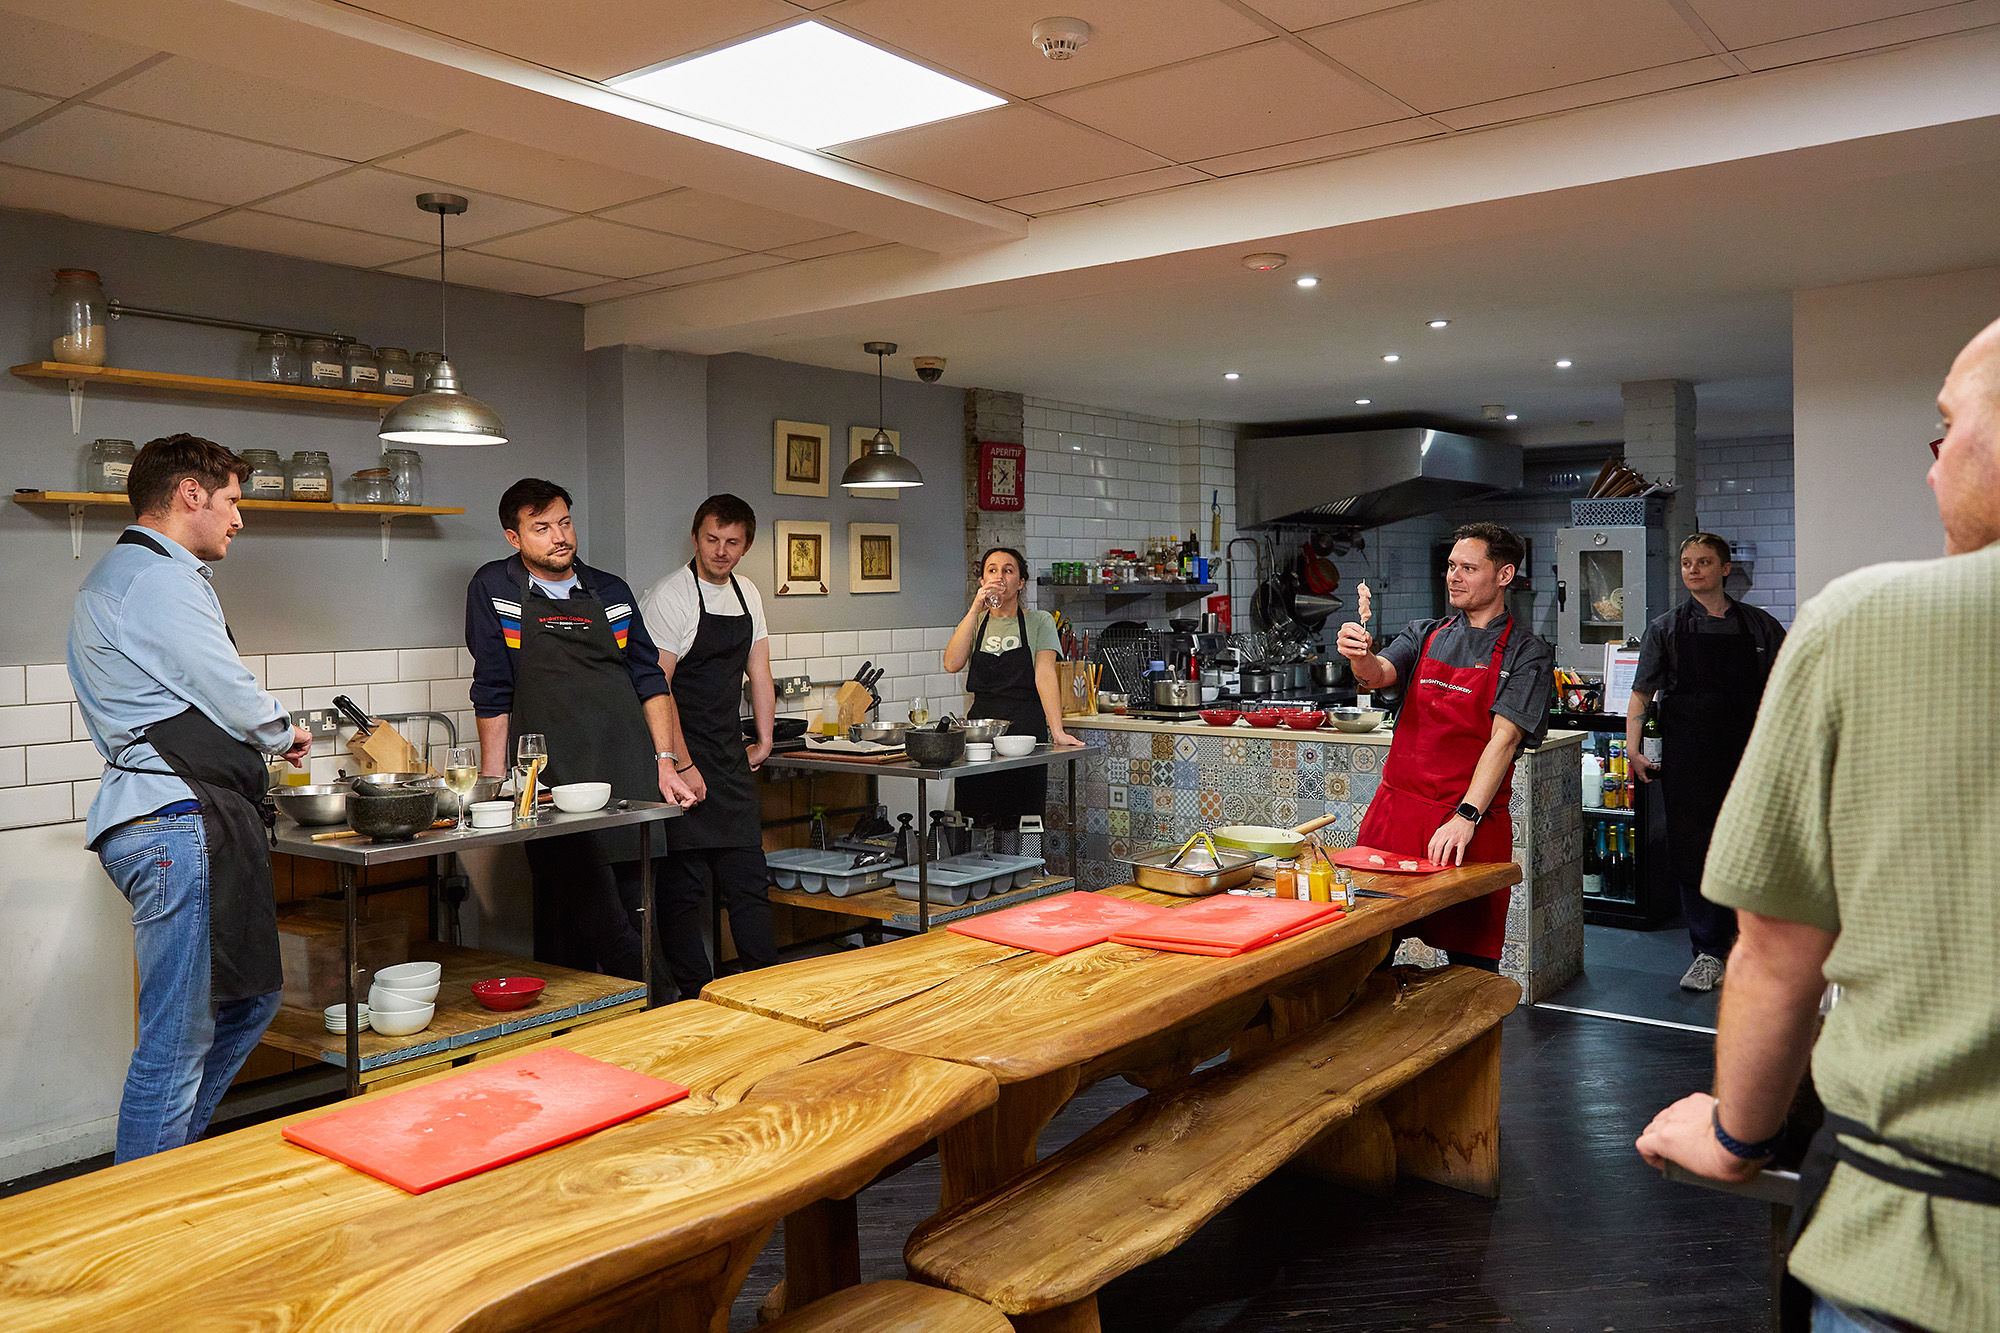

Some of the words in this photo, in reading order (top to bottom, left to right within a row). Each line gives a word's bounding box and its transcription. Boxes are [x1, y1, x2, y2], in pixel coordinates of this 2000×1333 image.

[991, 448, 1022, 457] APERITIF
[990, 497, 1019, 506] PASTIS
[1420, 679, 1448, 688] BRIGHTON
[1448, 684, 1472, 694] COOKERY
